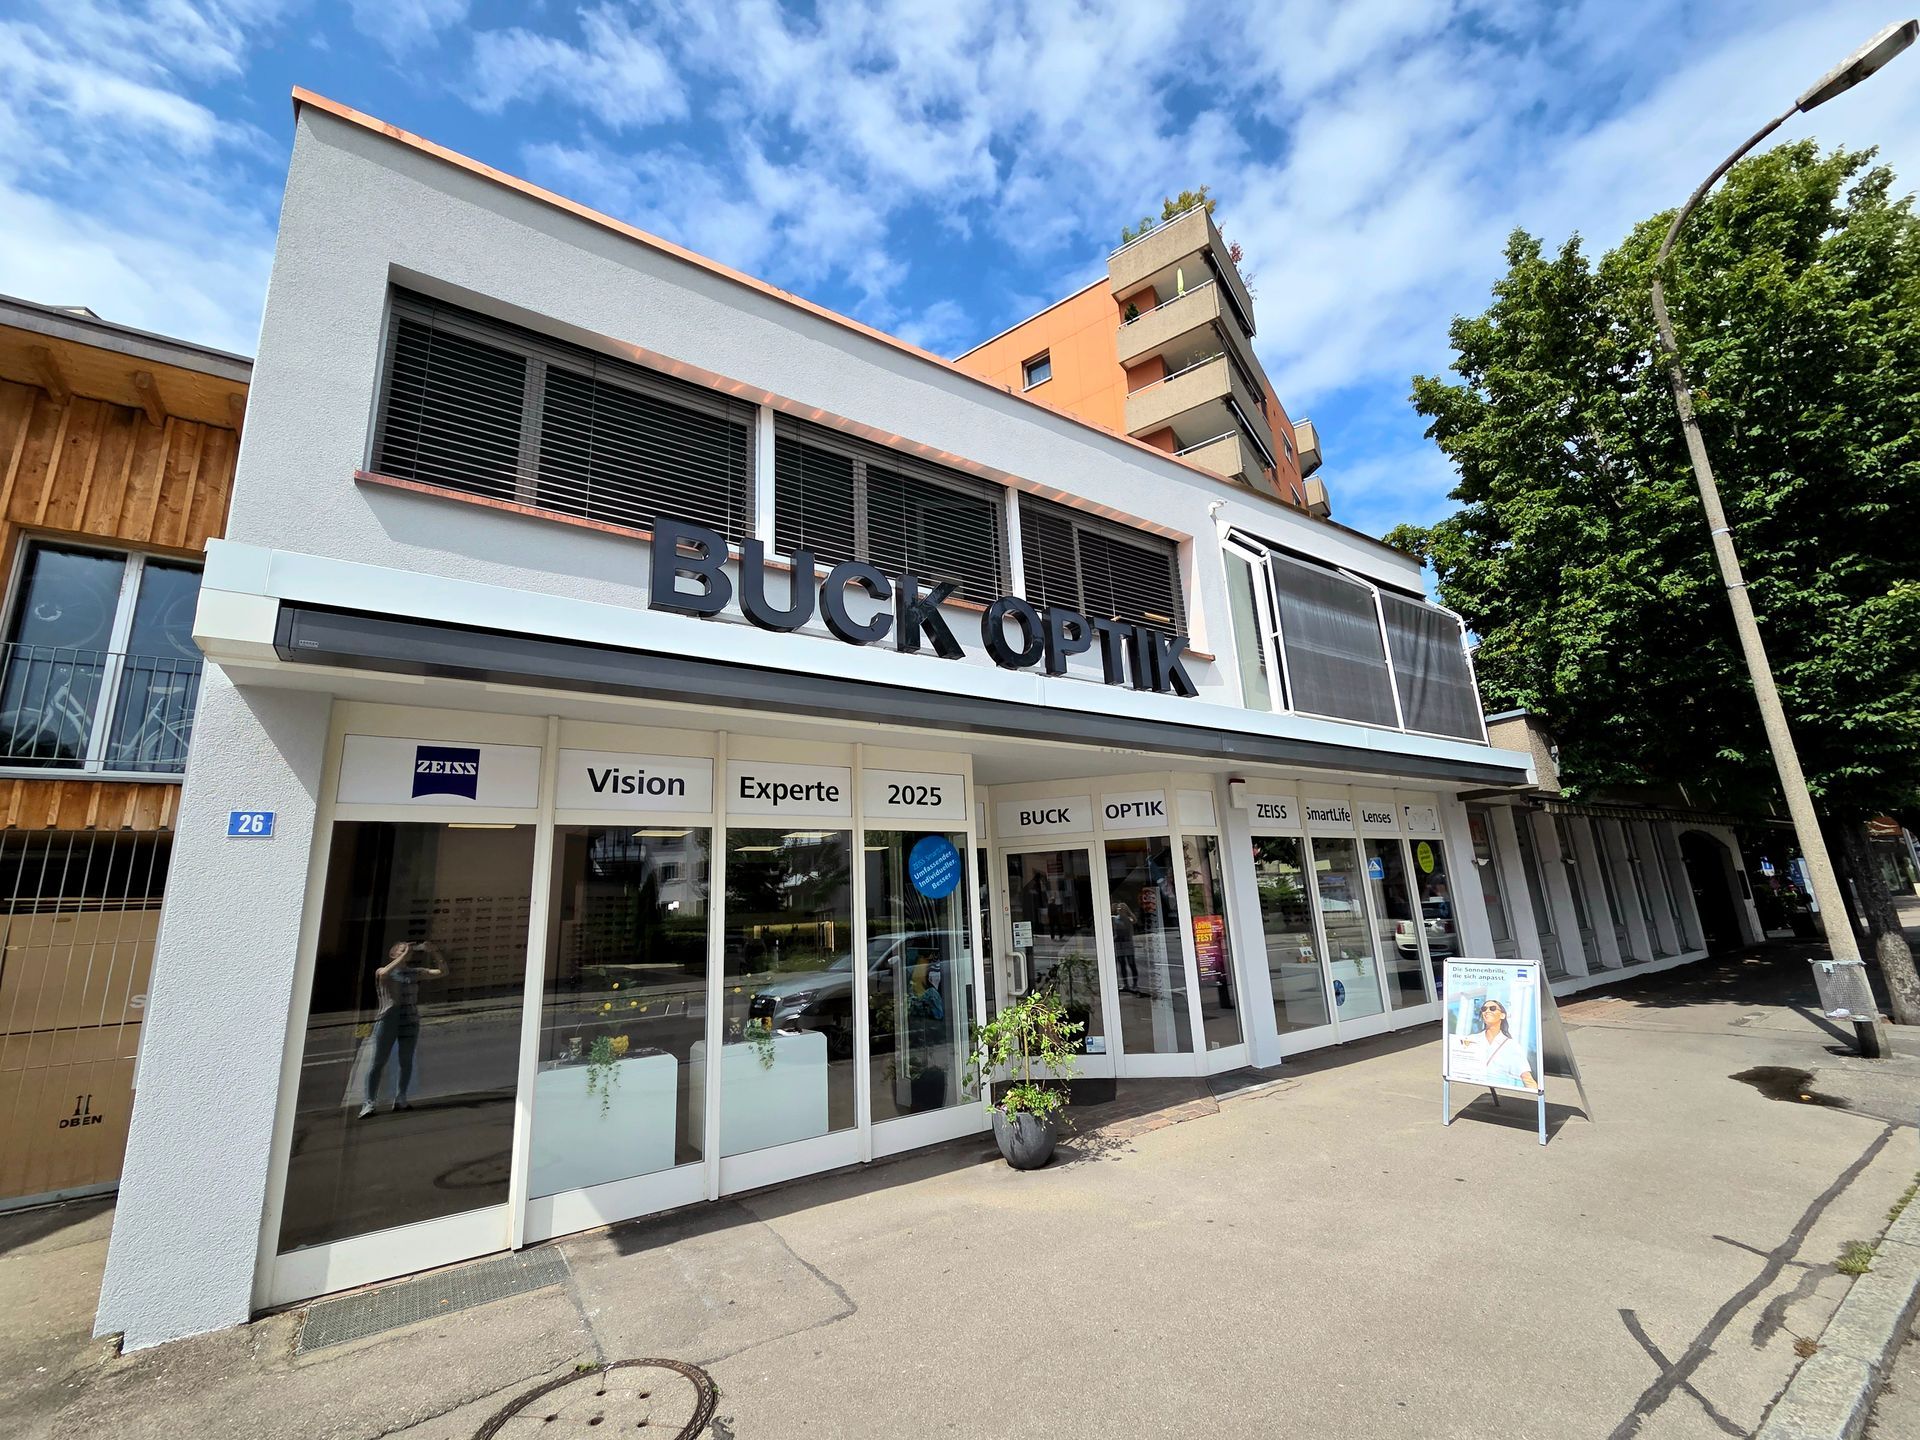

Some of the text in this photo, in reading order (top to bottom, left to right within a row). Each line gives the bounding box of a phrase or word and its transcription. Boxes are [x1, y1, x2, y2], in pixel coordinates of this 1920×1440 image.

[647, 515, 1199, 698] BUCK OPTIK
[416, 759, 477, 775] ZEISS
[586, 767, 943, 807] Vision Experte 2025
[237, 813, 264, 834] 26
[1019, 800, 1164, 826] BUCK OPTIK
[1256, 803, 1288, 820] ZEISS
[1362, 809, 1392, 824] Lenses
[59, 1114, 103, 1129] OBEN
